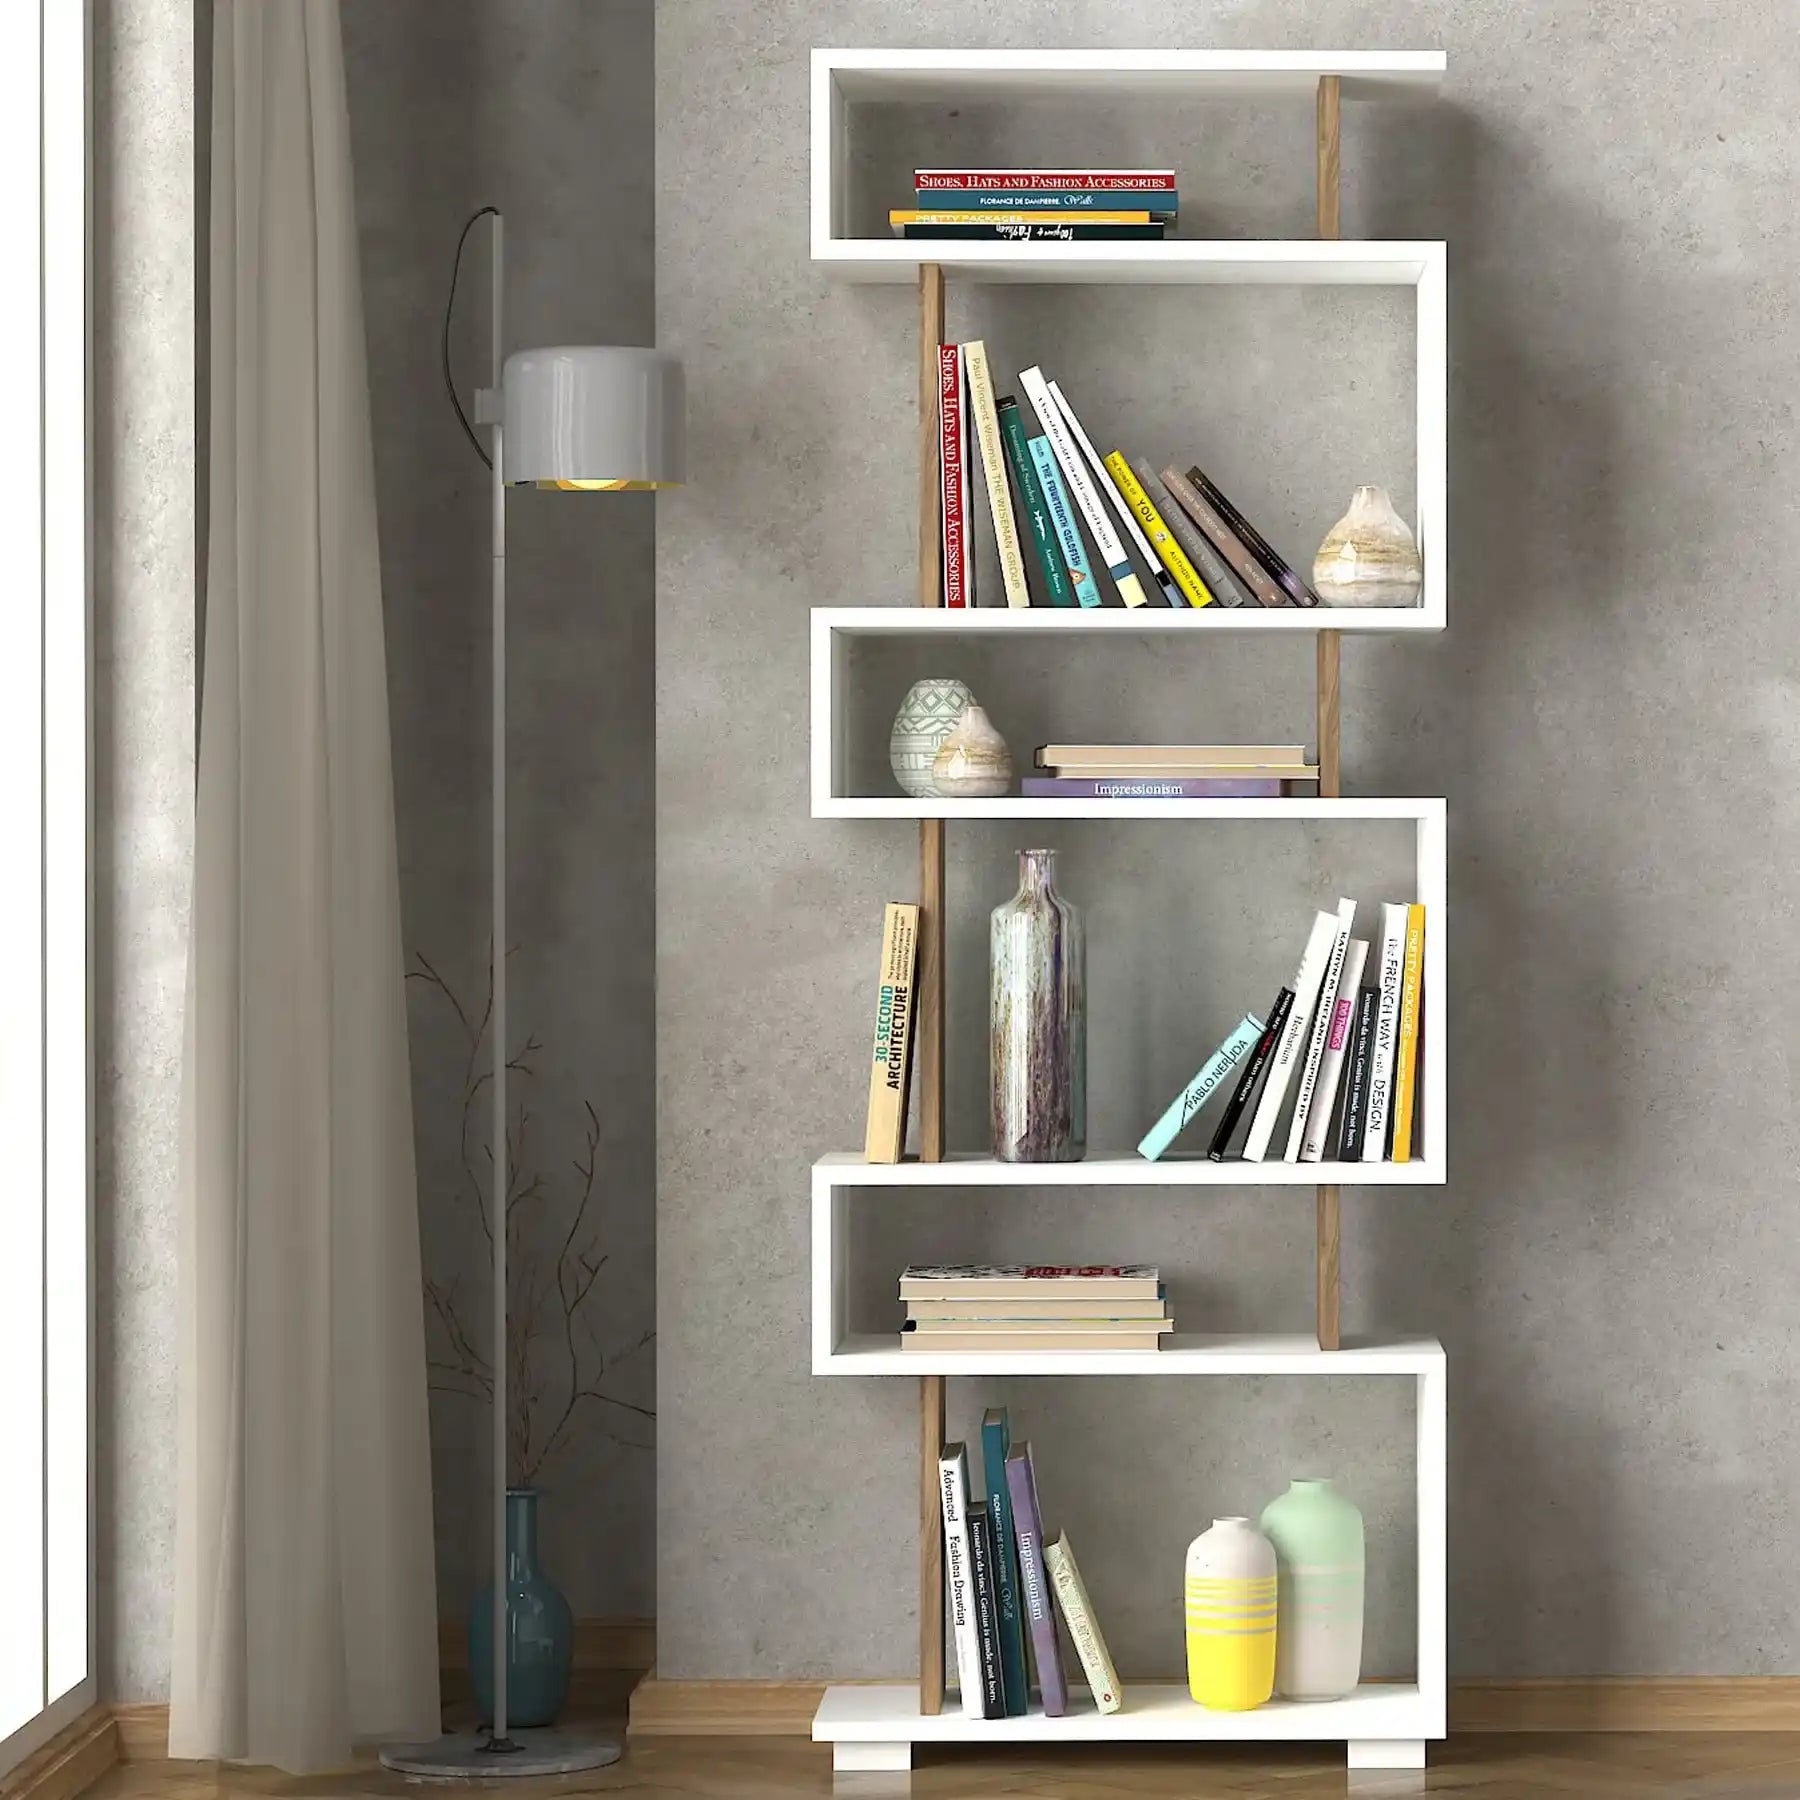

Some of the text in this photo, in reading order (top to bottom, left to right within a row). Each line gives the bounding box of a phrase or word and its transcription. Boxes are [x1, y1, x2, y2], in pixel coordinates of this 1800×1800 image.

[920, 176, 1166, 188] SHOES, HATS AND FASHION ACCESSORIES
[972, 357, 982, 379] Paul
[976, 383, 988, 420] Vincent
[984, 424, 998, 471] Wiseman
[942, 350, 960, 600] SHOES, HATS AND FASHION ACCESSORIES
[992, 474, 1003, 495] THE
[997, 497, 1012, 548] WISEMAN
[1040, 463, 1053, 479] THE
[1063, 529, 1081, 566] GOLDFISH
[1136, 499, 1154, 523] YOU
[1094, 782, 1183, 798] Impressionism
[1332, 931, 1346, 976] KATHRYN
[1327, 978, 1335, 993] M.
[1382, 959, 1397, 1014] FRENCH
[1403, 930, 1417, 1037] PRETTY PACKAGES
[1280, 992, 1291, 1015] some
[1316, 997, 1331, 1045] IRELAND
[887, 986, 907, 1089] ARCHITECTURE
[1272, 1015, 1281, 1029] are
[1330, 1016, 1349, 1049] THINGS
[1378, 1017, 1391, 1049] WAY
[1280, 1015, 1304, 1065] Herbarium
[1187, 1039, 1249, 1111] PABLO NERUDA
[1251, 1057, 1263, 1076] than
[1302, 1048, 1319, 1102] INSPIRED
[1354, 1058, 1364, 1083] Genius
[1239, 1076, 1254, 1103] others
[1368, 1079, 1385, 1133] DESIGN.
[944, 1469, 958, 1522] Advanced
[949, 1535, 961, 1577] Fashion
[973, 1522, 984, 1559] leonardo
[976, 1560, 984, 1571] da
[1020, 1531, 1043, 1620] Impressionism
[953, 1579, 966, 1626] Drawing
[979, 1597, 990, 1627] Genius
[983, 1628, 990, 1636] is
[983, 1637, 994, 1663] made,
[986, 1664, 994, 1678] not
[987, 1680, 998, 1703] born.
